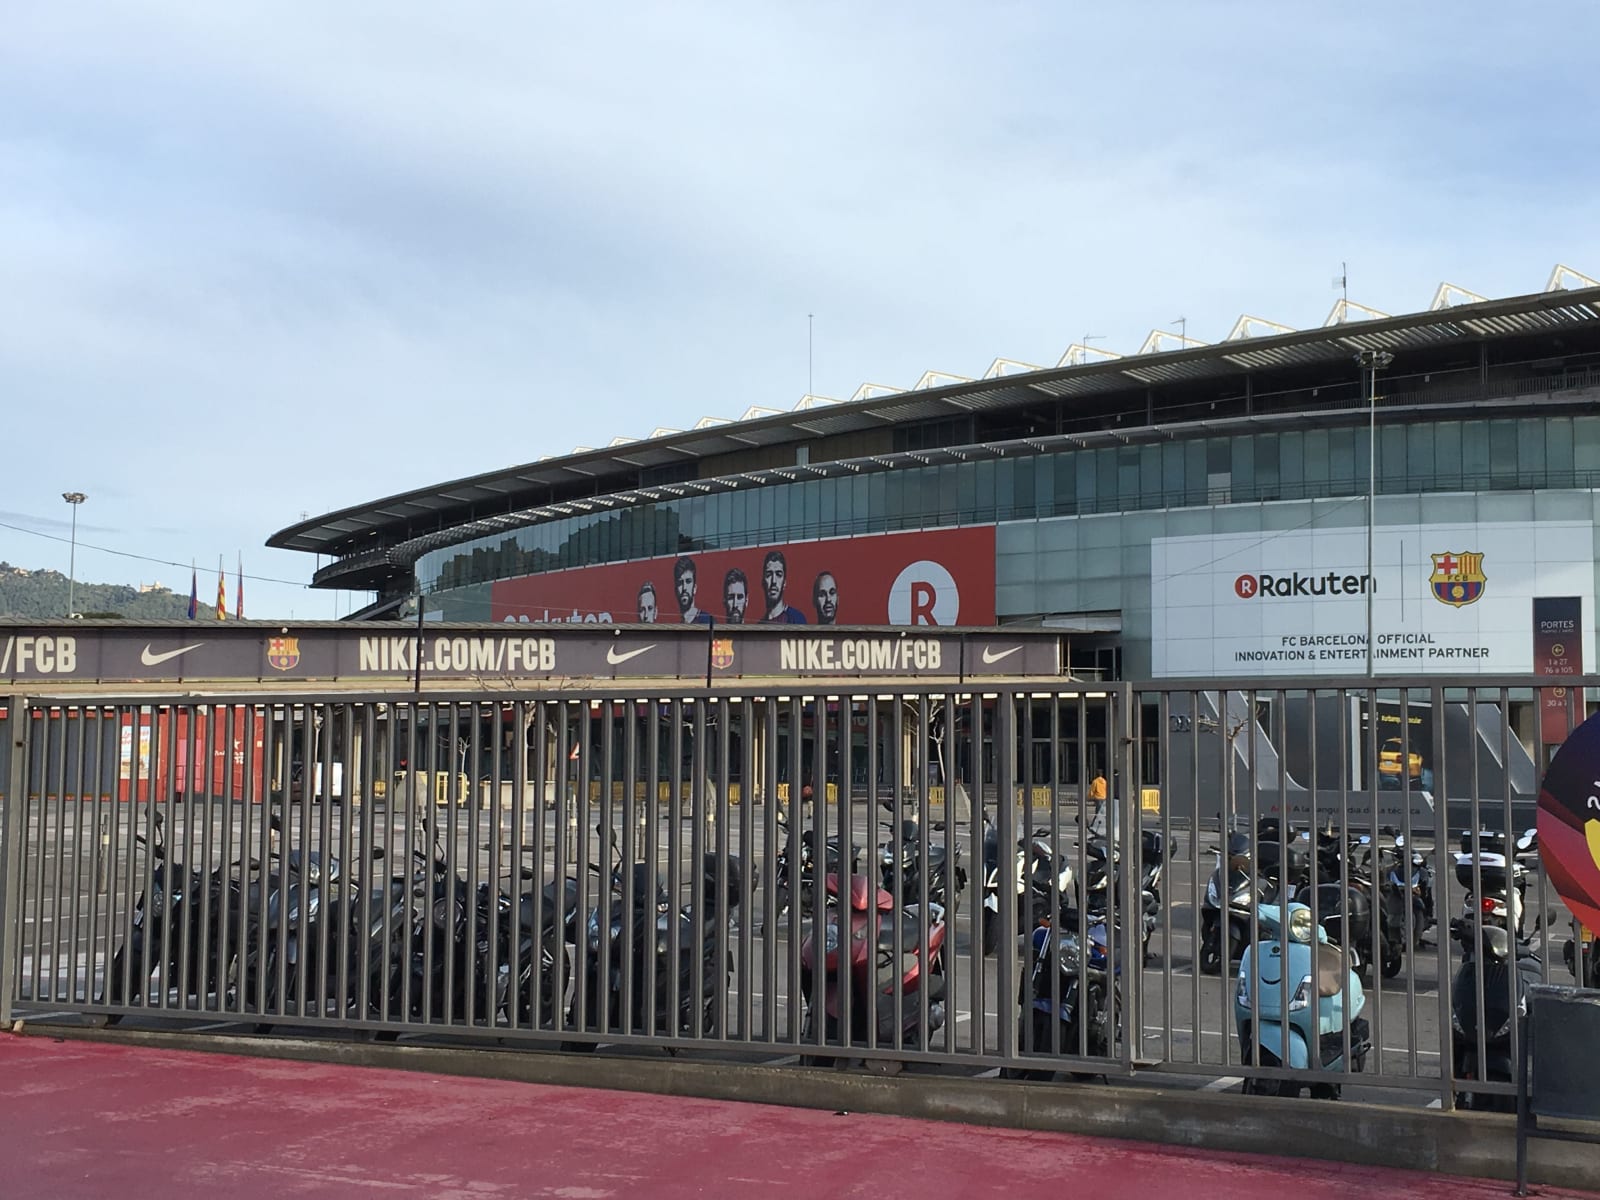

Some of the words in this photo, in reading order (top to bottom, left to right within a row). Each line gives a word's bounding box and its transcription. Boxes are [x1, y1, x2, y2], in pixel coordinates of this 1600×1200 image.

[1259, 572, 1377, 597] Rakuten
[911, 581, 938, 625] R
[1540, 620, 1574, 629] PORTES
[359, 636, 556, 672] NIKE.COM/FCB
[780, 638, 941, 670] NIKE.COM/FCB
[1282, 636, 1297, 647] FC
[1300, 634, 1370, 646] BARCELON
[1377, 633, 1435, 645] OFFICIAL
[0, 636, 76, 673] /FCB
[1235, 650, 1305, 662] INNOVATION
[1308, 649, 1316, 660] &
[1319, 647, 1425, 660] ENTERTINMENT
[1429, 647, 1489, 659] PARTNER
